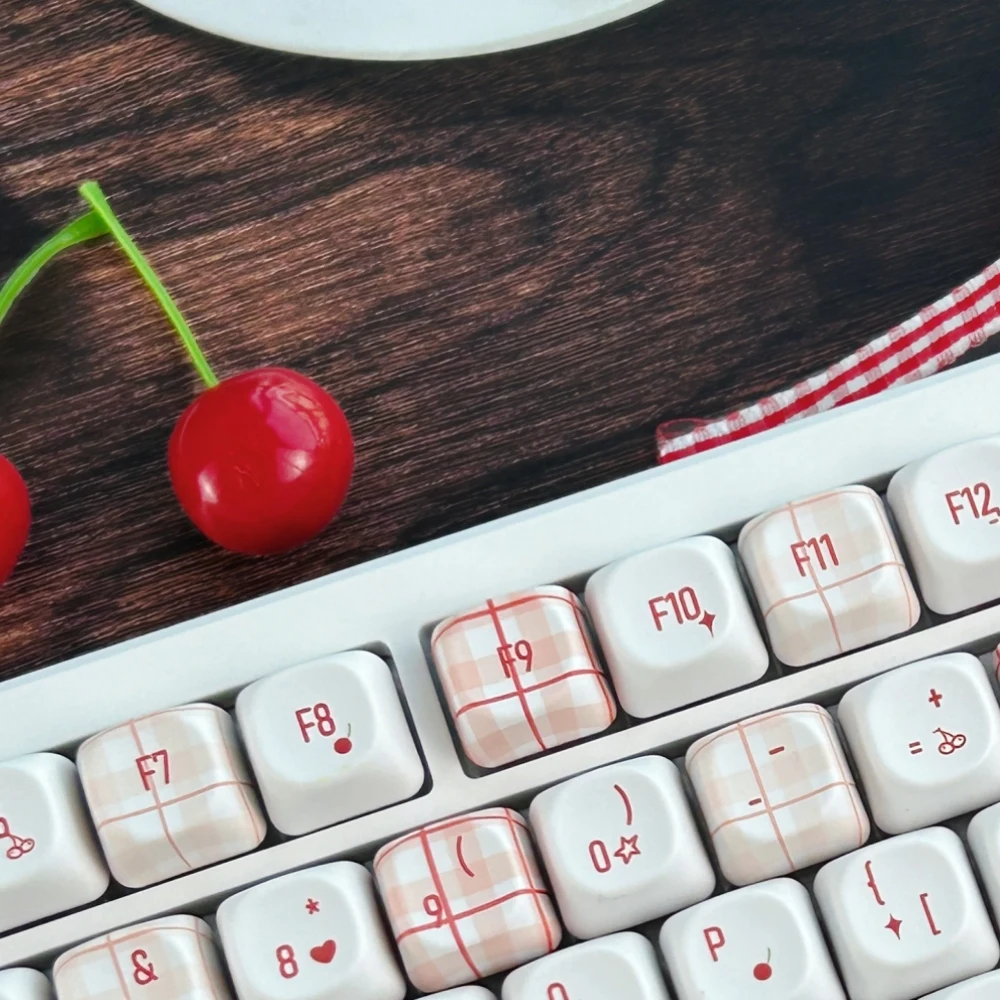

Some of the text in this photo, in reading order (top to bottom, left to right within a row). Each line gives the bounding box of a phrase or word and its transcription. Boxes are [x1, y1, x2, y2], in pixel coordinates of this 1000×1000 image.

[945, 482, 1000, 525] F12
[790, 533, 840, 577] F11
[648, 586, 702, 631] F10
[495, 640, 534, 678] F9
[296, 703, 337, 744] F8
[135, 749, 172, 792] F7
[422, 894, 447, 928] 9
[277, 945, 298, 978] 8
[704, 927, 725, 961] P
[131, 949, 159, 986] &
